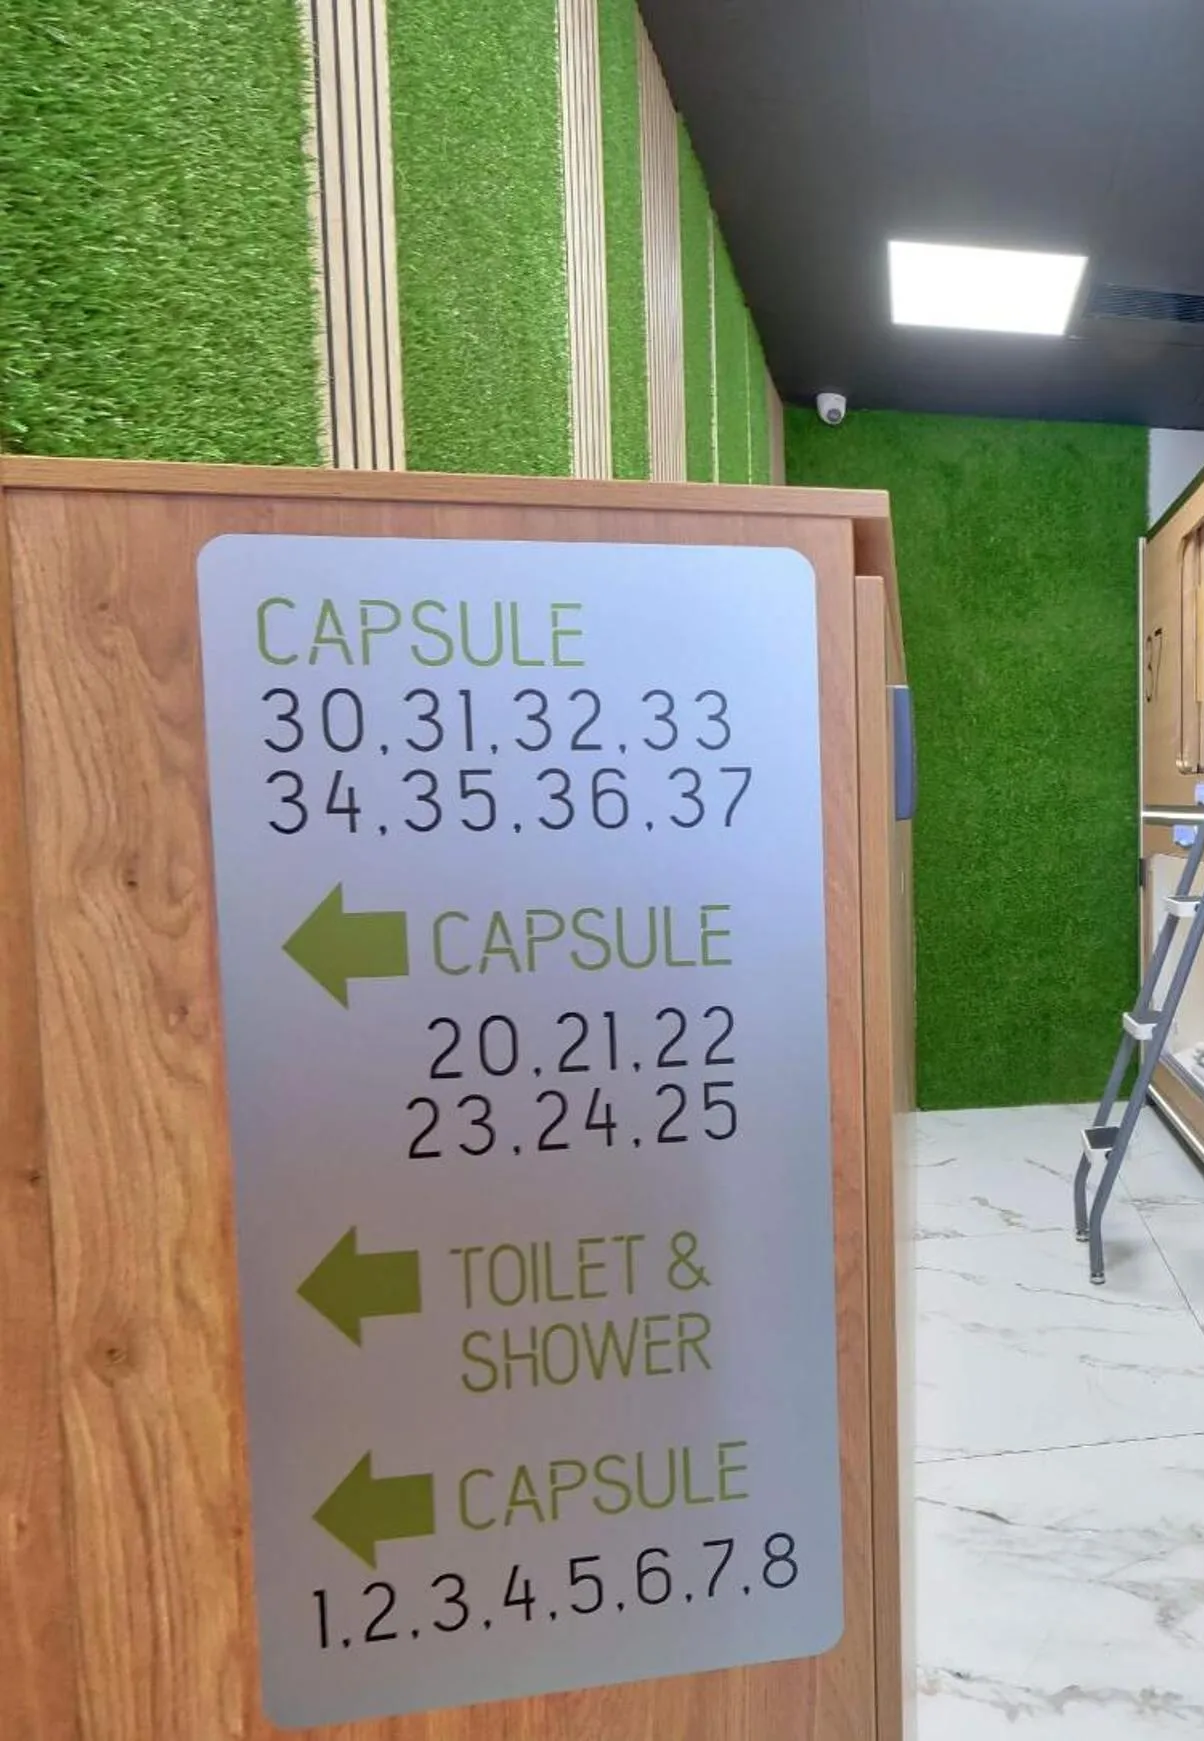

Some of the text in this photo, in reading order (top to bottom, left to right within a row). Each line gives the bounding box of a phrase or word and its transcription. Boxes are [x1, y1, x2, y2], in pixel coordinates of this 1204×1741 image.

[257, 597, 585, 666] CAPSULE
[261, 687, 731, 755] 30,31,32,33
[266, 767, 752, 835] 34,35,36,37
[432, 904, 733, 976] CAPSULE
[428, 1005, 736, 1079] 20,21,22
[406, 1081, 737, 1158] 23,24,25
[450, 1230, 712, 1309] TOILET &
[461, 1312, 712, 1393] SHOWER
[458, 1441, 748, 1531] CAPSULE
[313, 1532, 799, 1650] 1,2,3,4,5,6,7,8
